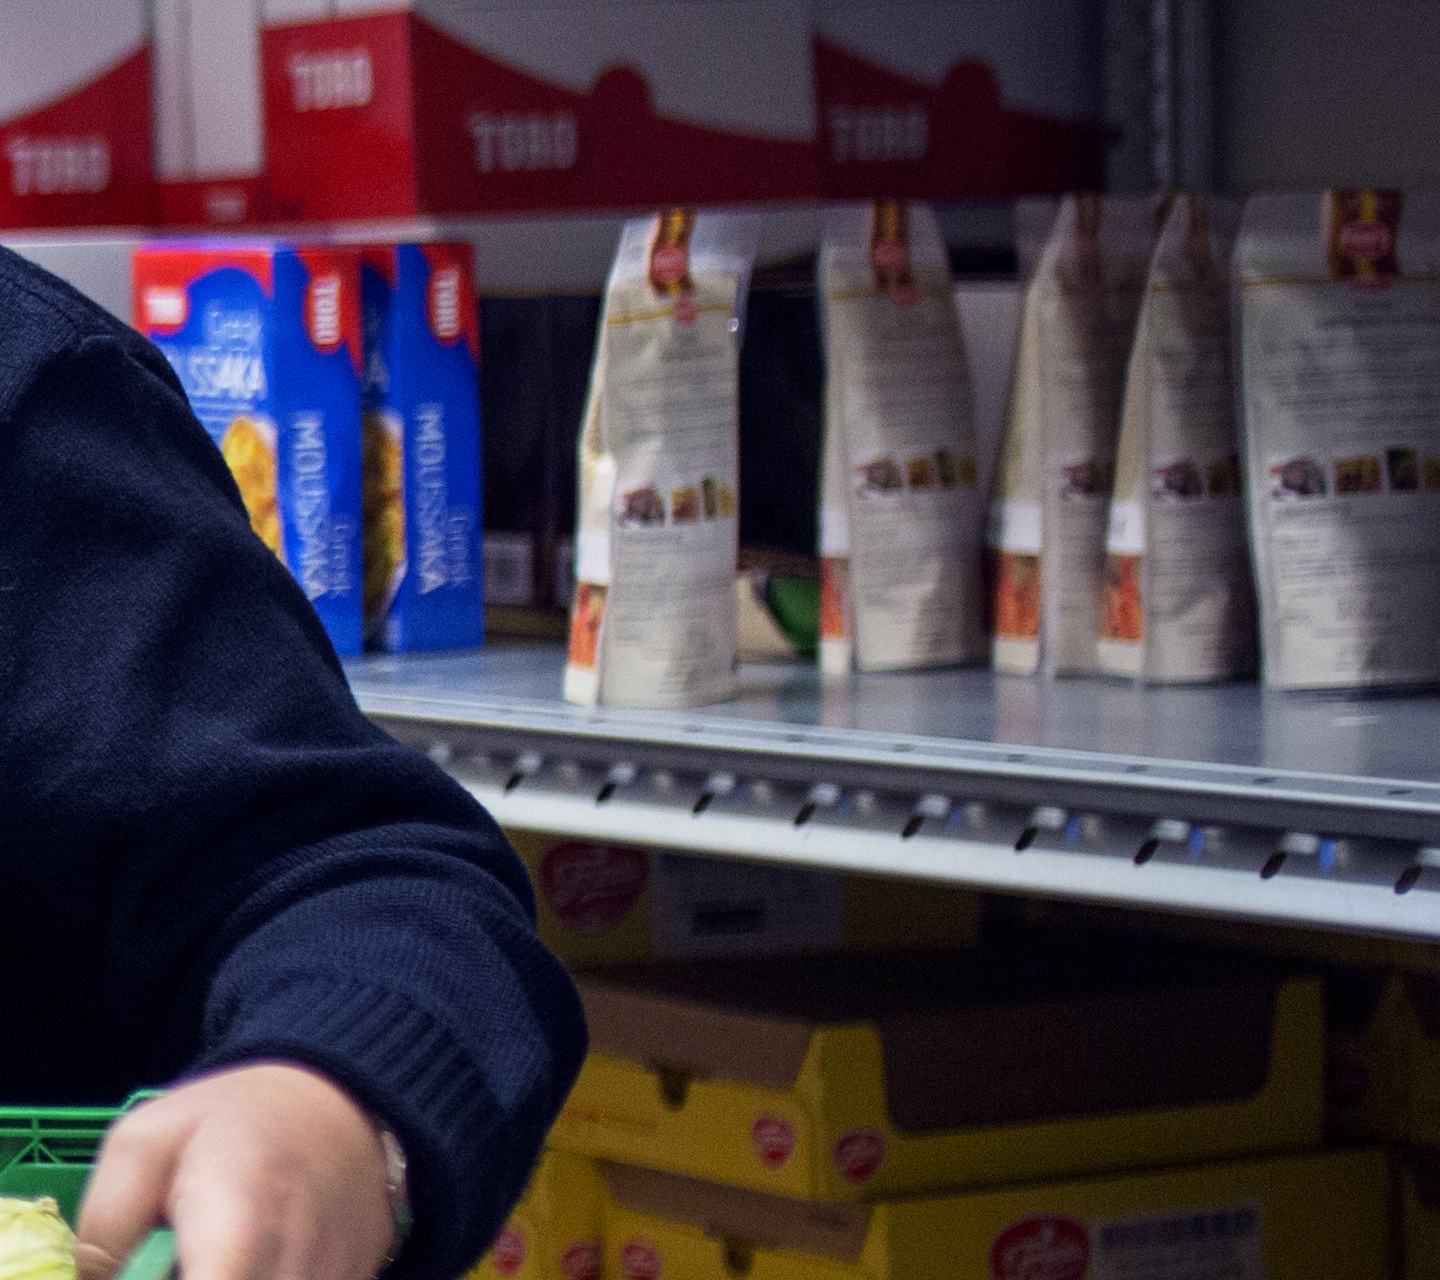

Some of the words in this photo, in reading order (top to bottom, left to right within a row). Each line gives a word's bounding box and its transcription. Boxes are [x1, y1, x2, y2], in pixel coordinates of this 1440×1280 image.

[291, 50, 372, 107] TORO
[292, 416, 333, 602] MOUSSAKA
[416, 409, 448, 595] MOUSSAKA
